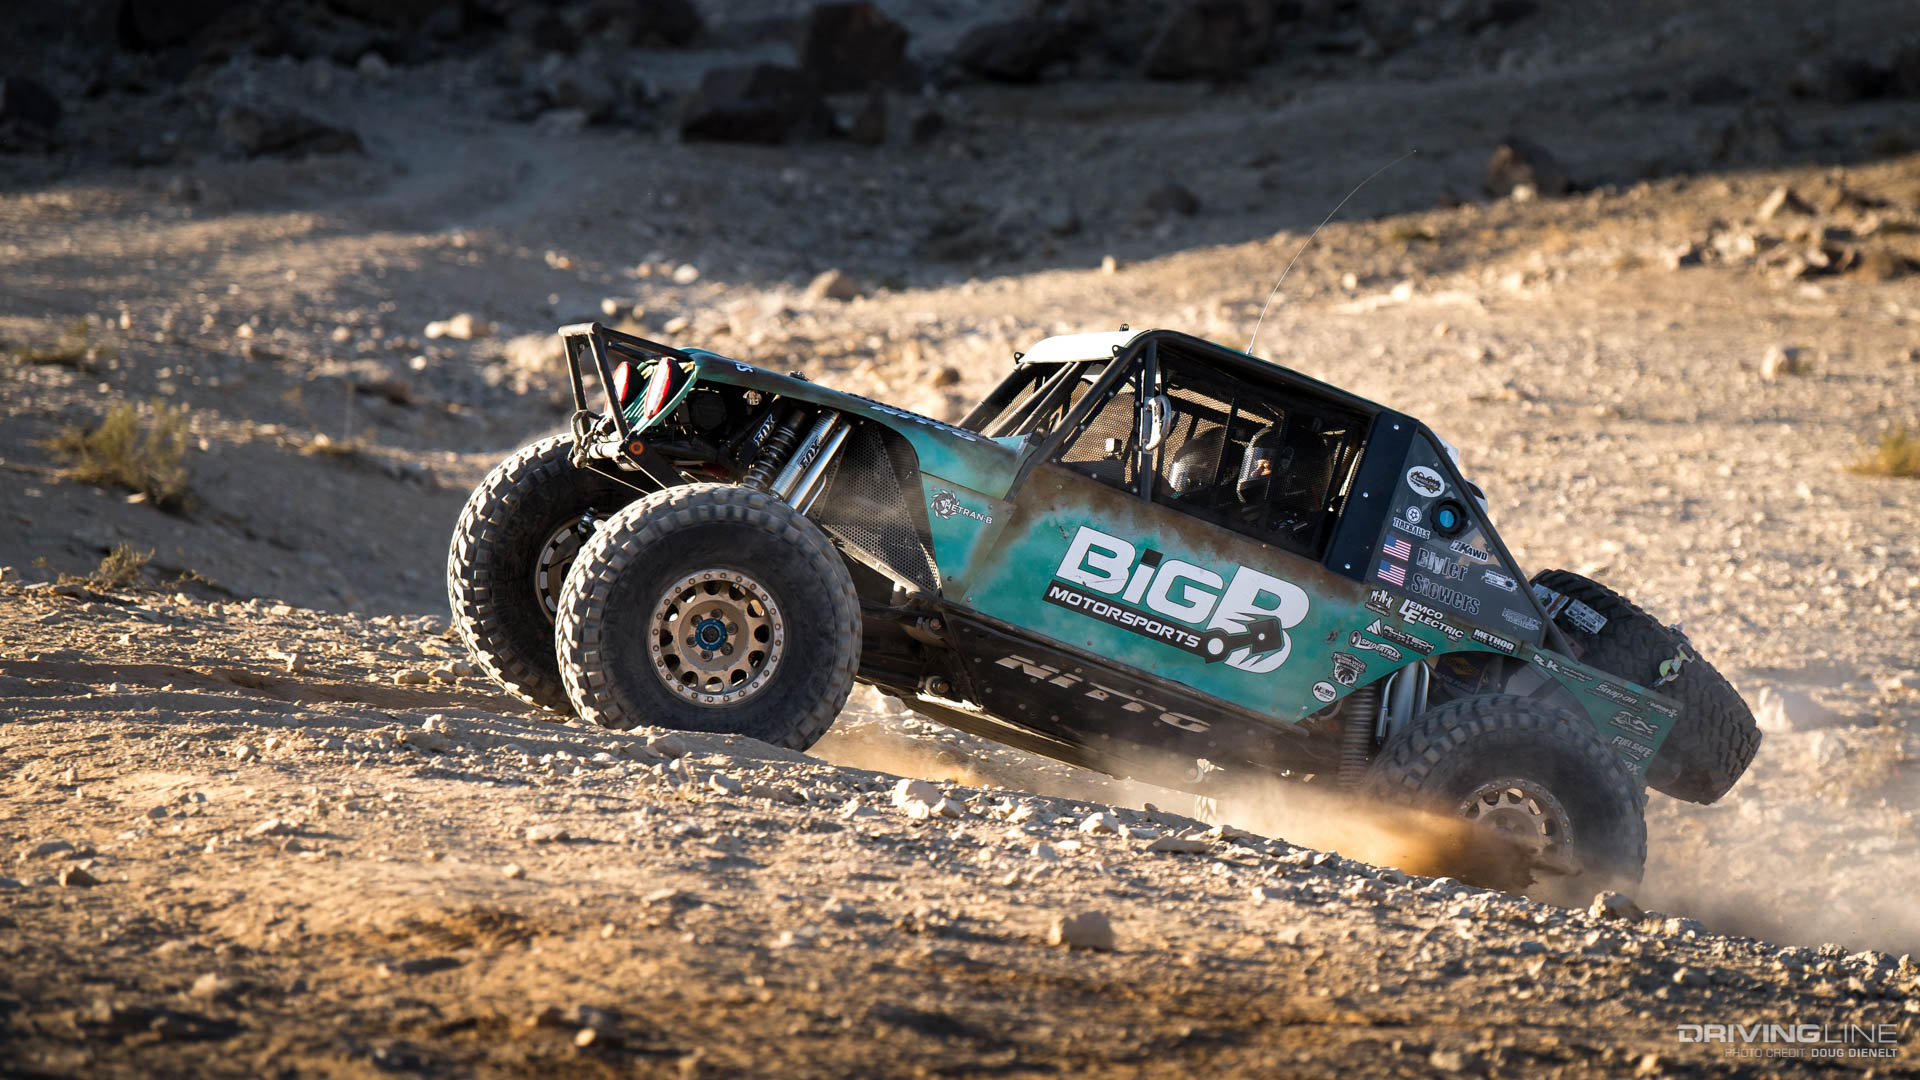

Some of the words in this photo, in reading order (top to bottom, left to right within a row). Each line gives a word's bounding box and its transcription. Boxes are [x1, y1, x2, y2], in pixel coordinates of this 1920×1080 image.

[753, 413, 775, 447] FOX
[799, 436, 820, 470] FOX
[1417, 547, 1469, 582] Blyler
[1399, 599, 1444, 621] LEMCO
[1411, 573, 1481, 616] Stowers
[1048, 585, 1202, 649] MOTORSPORTS
[1404, 607, 1465, 639] ELECTRIC
[1360, 638, 1402, 659] SPIDERTRAX
[1473, 628, 1515, 651] METHOD
[1596, 682, 1638, 705] Snap-on
[1612, 735, 1632, 750] FUEL
[1631, 742, 1654, 759] SAFE
